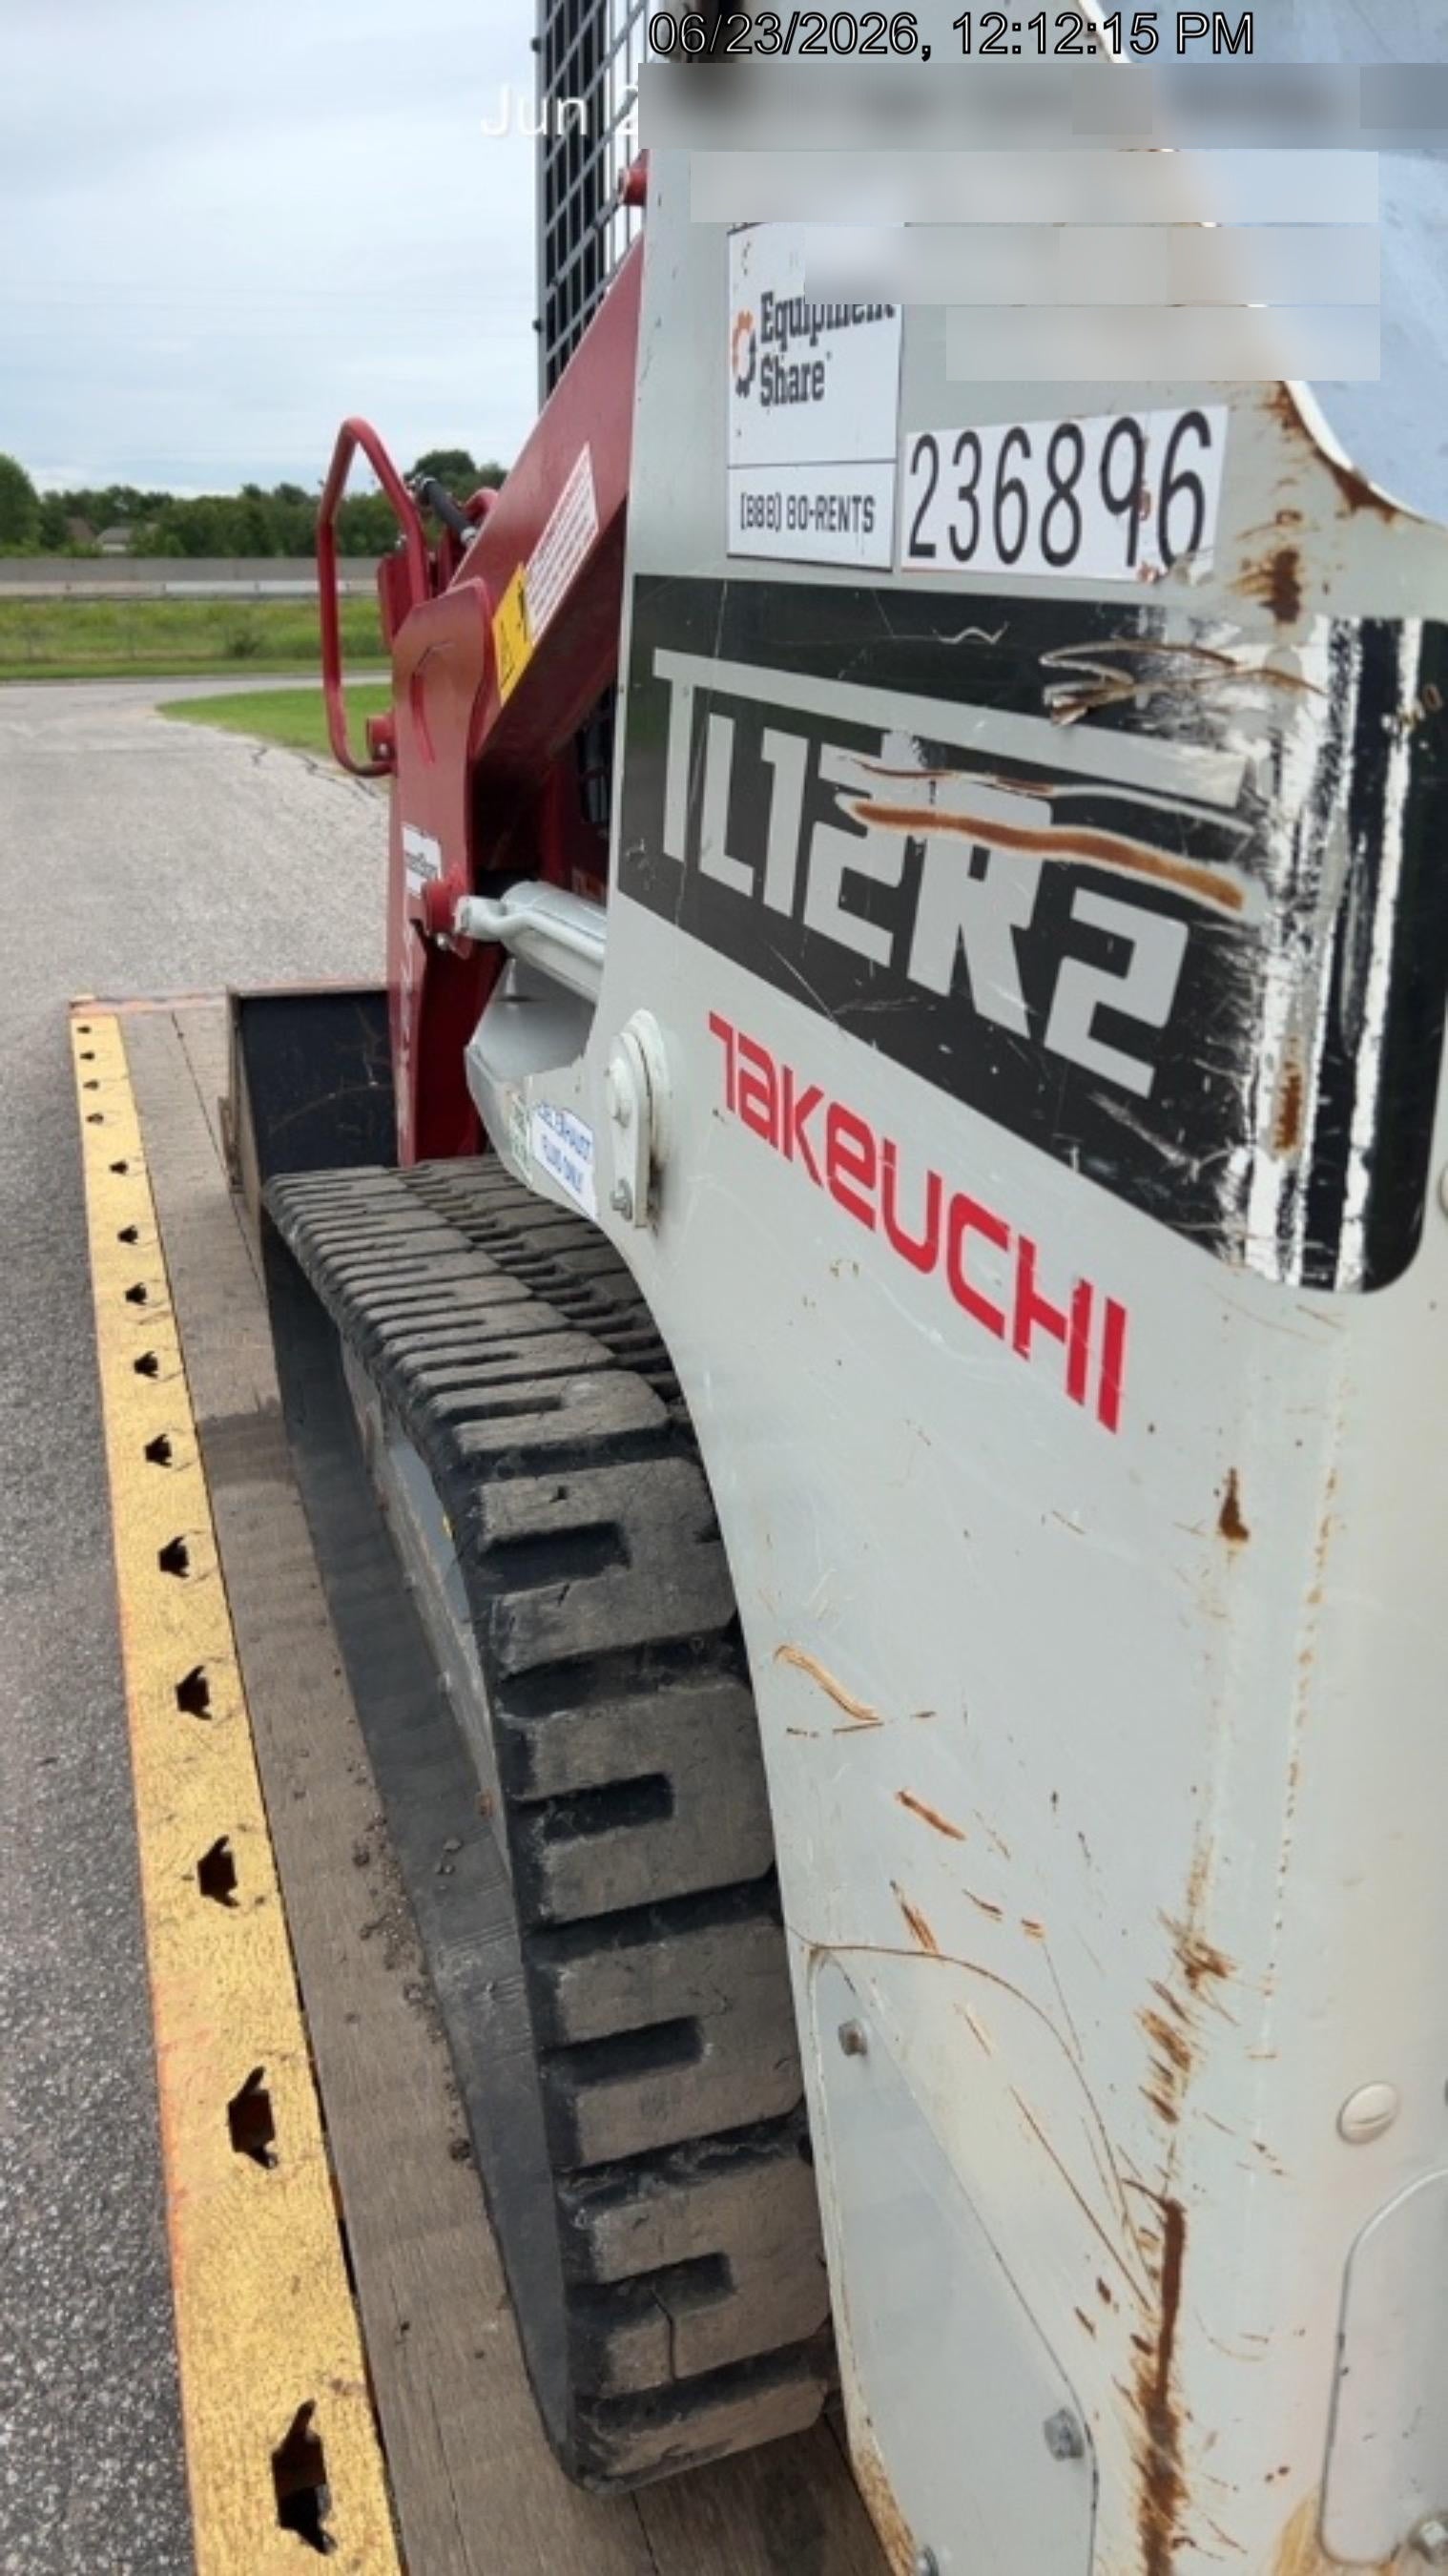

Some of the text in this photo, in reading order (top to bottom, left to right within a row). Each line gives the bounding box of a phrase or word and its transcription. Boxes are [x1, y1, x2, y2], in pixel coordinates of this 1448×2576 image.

[760, 352, 825, 406] Share
[786, 494, 876, 533] 80-RENTS
[909, 410, 1212, 571] 236896
